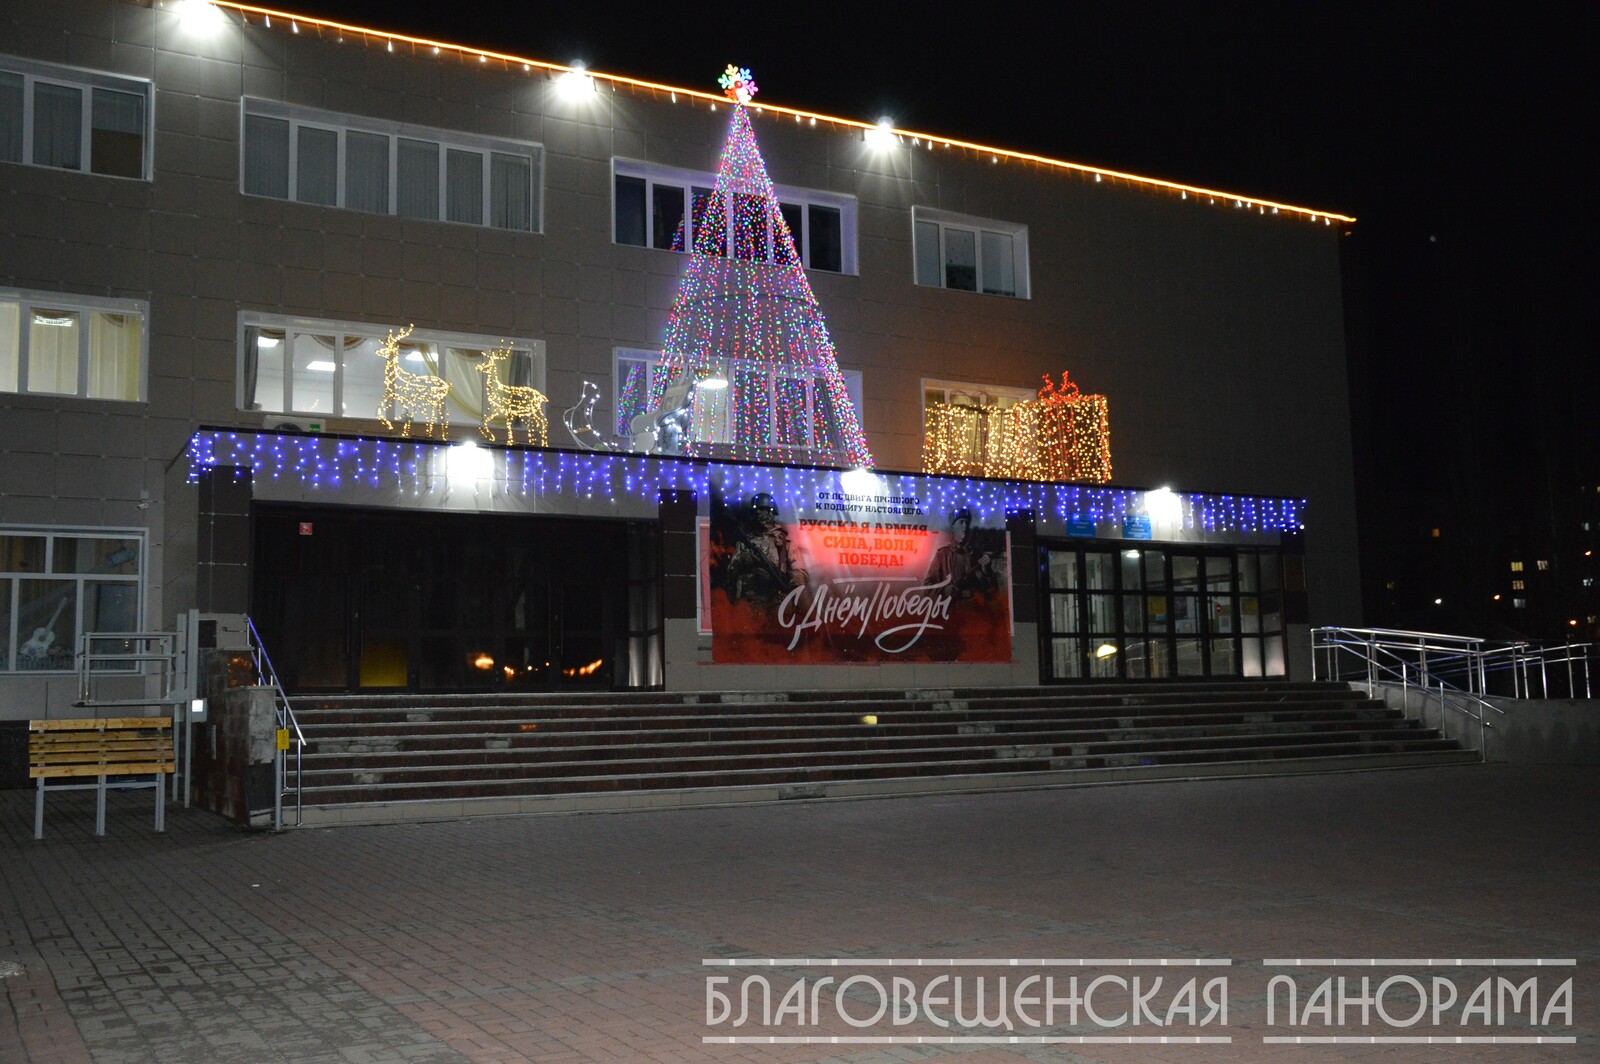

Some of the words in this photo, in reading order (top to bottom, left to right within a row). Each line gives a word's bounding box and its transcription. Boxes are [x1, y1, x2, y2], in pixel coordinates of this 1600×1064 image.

[818, 491, 830, 501] ОТ
[831, 493, 873, 503] ПОДВИГА
[815, 502, 822, 510] К
[823, 502, 864, 512] ПОДВИГУ
[799, 518, 870, 534] РУССКАЯ
[874, 522, 928, 537] АРМИЯ
[823, 535, 873, 552] СИЛА,
[874, 538, 918, 554] ВОЛЯ,
[838, 552, 904, 568] ПОБЕДА!
